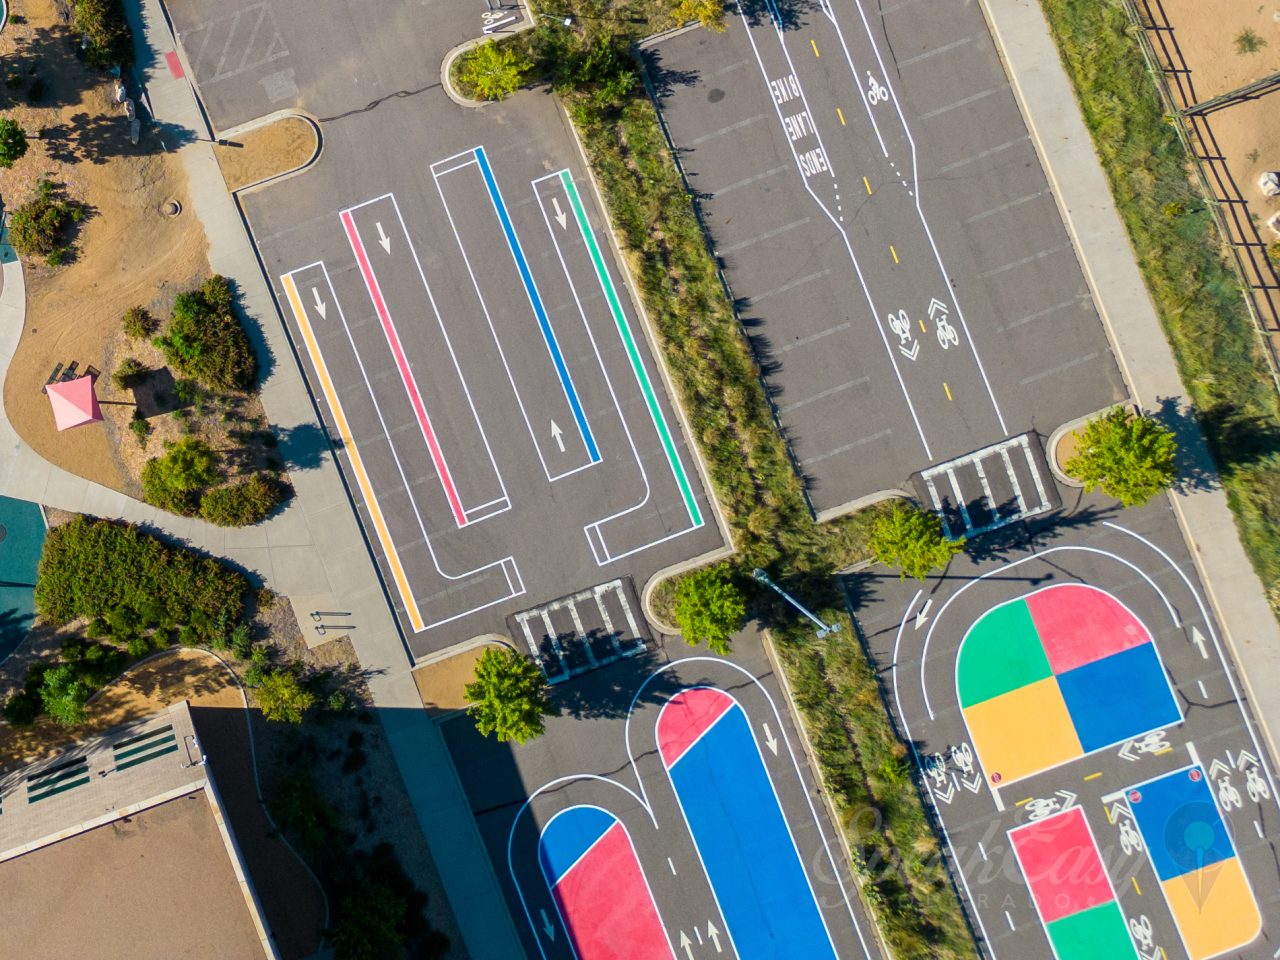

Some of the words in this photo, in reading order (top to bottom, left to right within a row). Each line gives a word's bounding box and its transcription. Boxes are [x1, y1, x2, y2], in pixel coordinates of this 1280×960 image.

[770, 73, 801, 104] BIKE
[784, 111, 814, 141] LANE
[799, 147, 827, 177] ENDS
